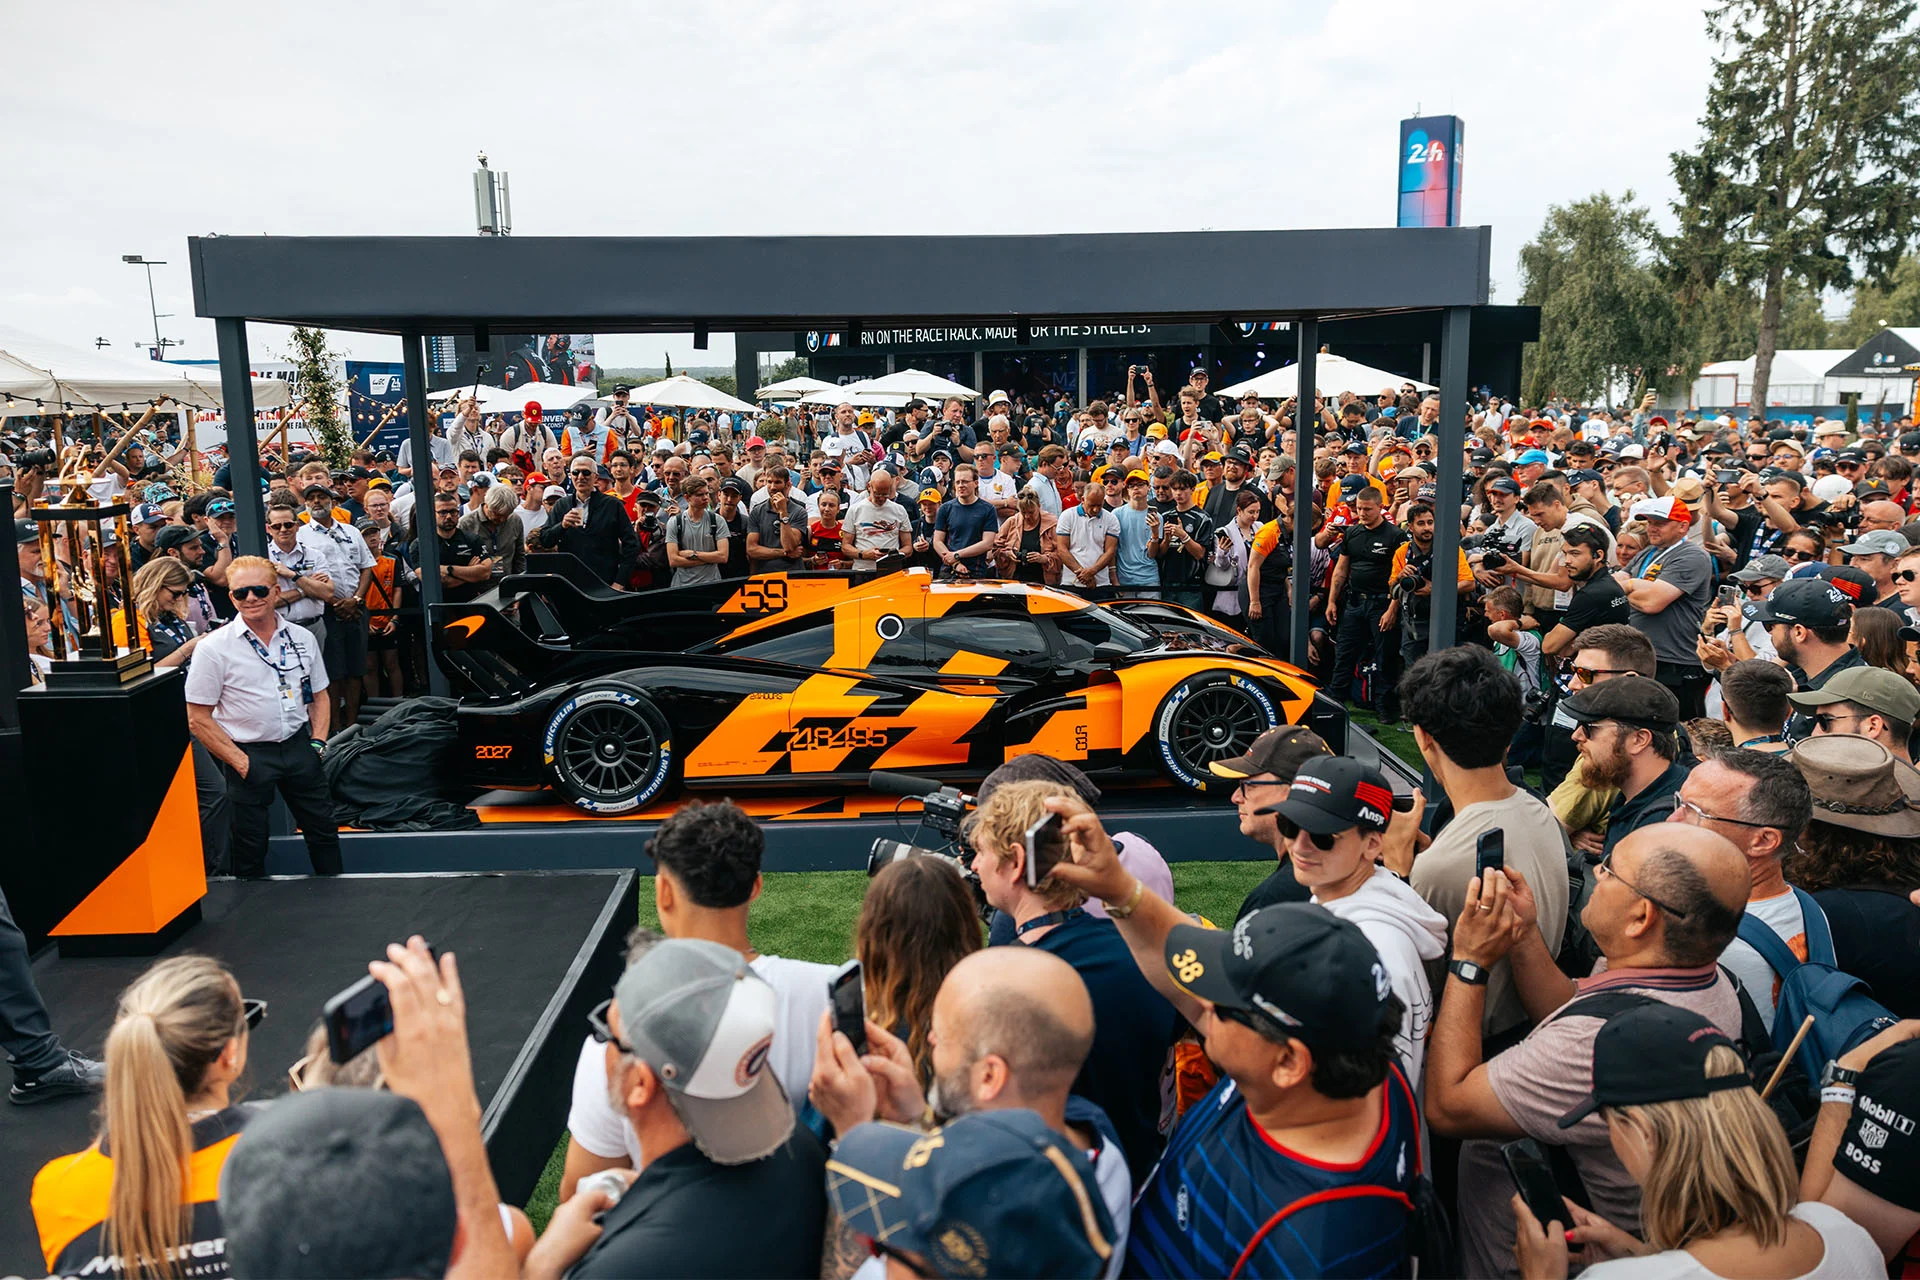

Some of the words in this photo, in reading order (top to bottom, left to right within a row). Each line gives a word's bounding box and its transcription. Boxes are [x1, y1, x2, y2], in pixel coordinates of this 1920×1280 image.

[876, 330, 891, 344] ON
[893, 329, 913, 343] THE
[915, 327, 983, 342] RACETRACK.
[740, 579, 789, 612] 59
[1246, 683, 1277, 723] MICHELIN
[545, 702, 574, 746] MICHELIN
[475, 745, 513, 759] 2027
[1161, 743, 1192, 784] MICHELIN
[639, 759, 669, 801] MICHELIN
[1172, 948, 1205, 984] 38
[1859, 1095, 1897, 1127] Mobil
[1845, 1141, 1882, 1175] BOSS
